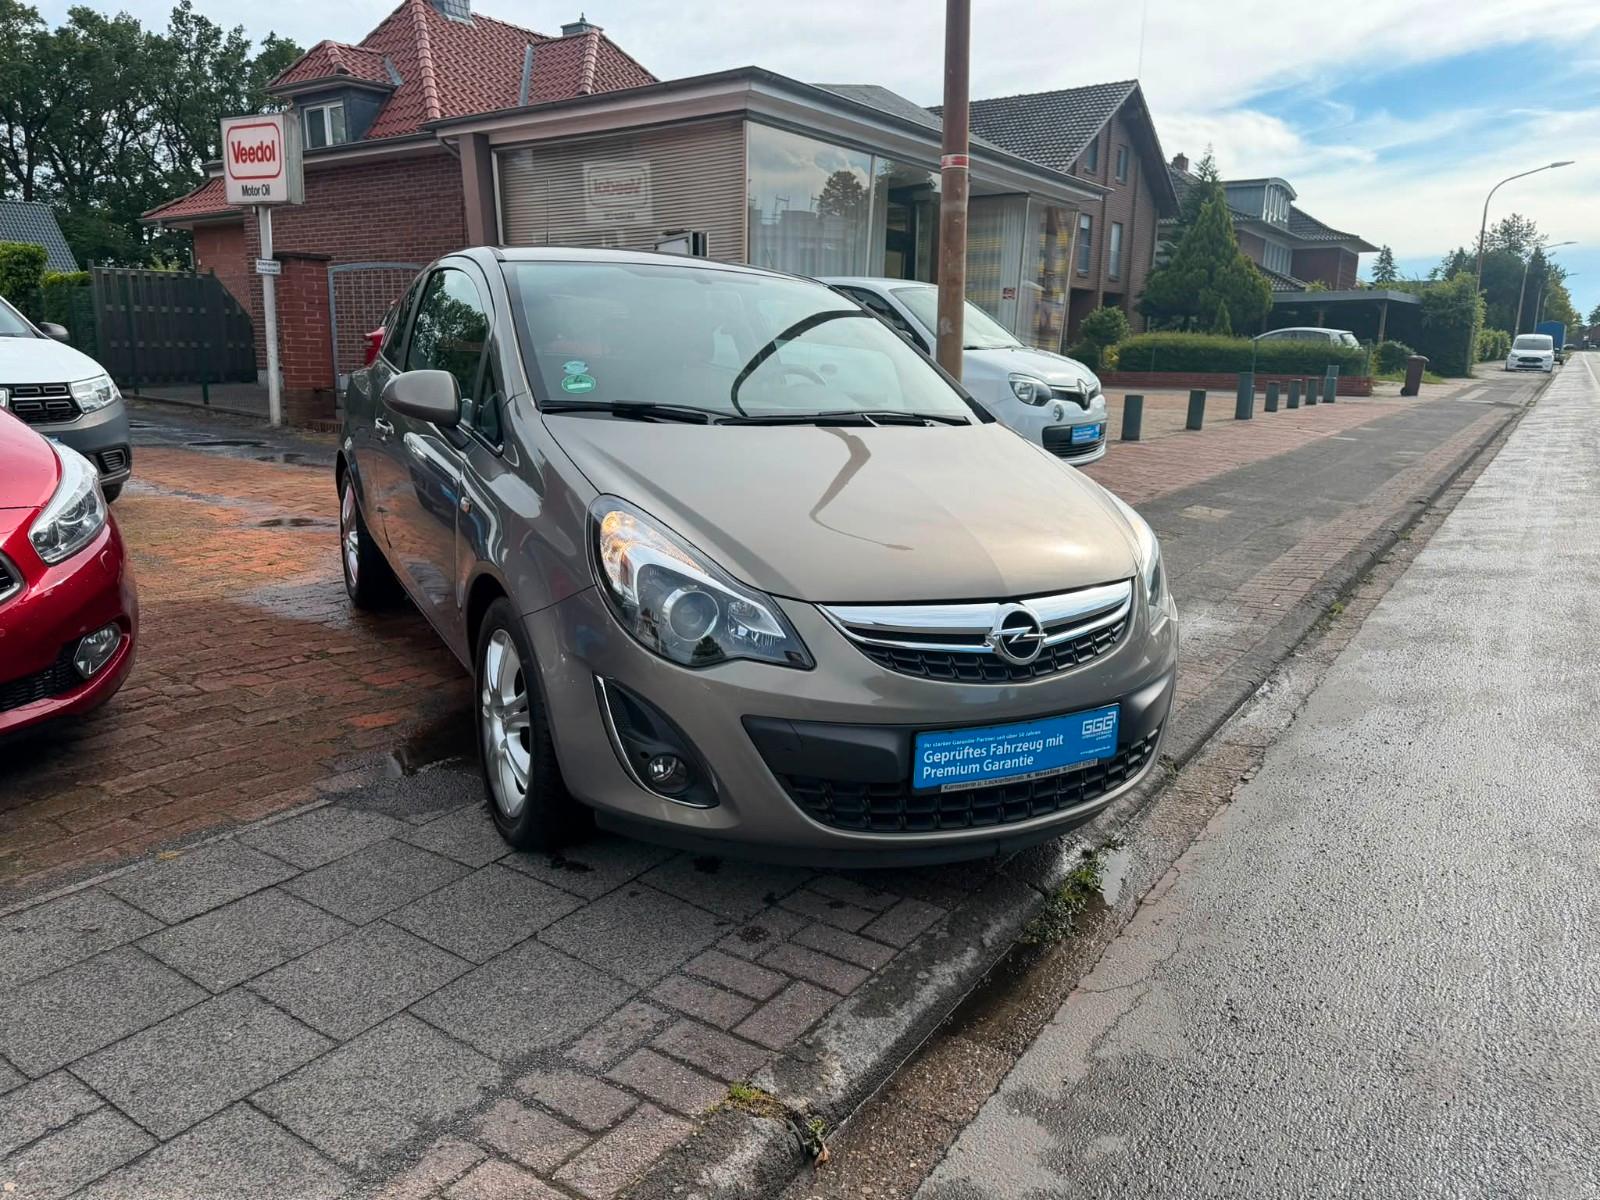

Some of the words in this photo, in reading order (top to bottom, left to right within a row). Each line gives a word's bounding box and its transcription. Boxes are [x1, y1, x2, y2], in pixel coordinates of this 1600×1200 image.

[231, 140, 276, 164] Veedol
[241, 184, 260, 197] Motor
[261, 183, 270, 196] Oil
[1082, 714, 1113, 735] GGG
[924, 746, 987, 764] Geprüftes
[990, 739, 1043, 755] Fahrzeug
[1046, 733, 1063, 747] mit
[923, 762, 980, 779] Premium
[983, 754, 1033, 771] Garantie
